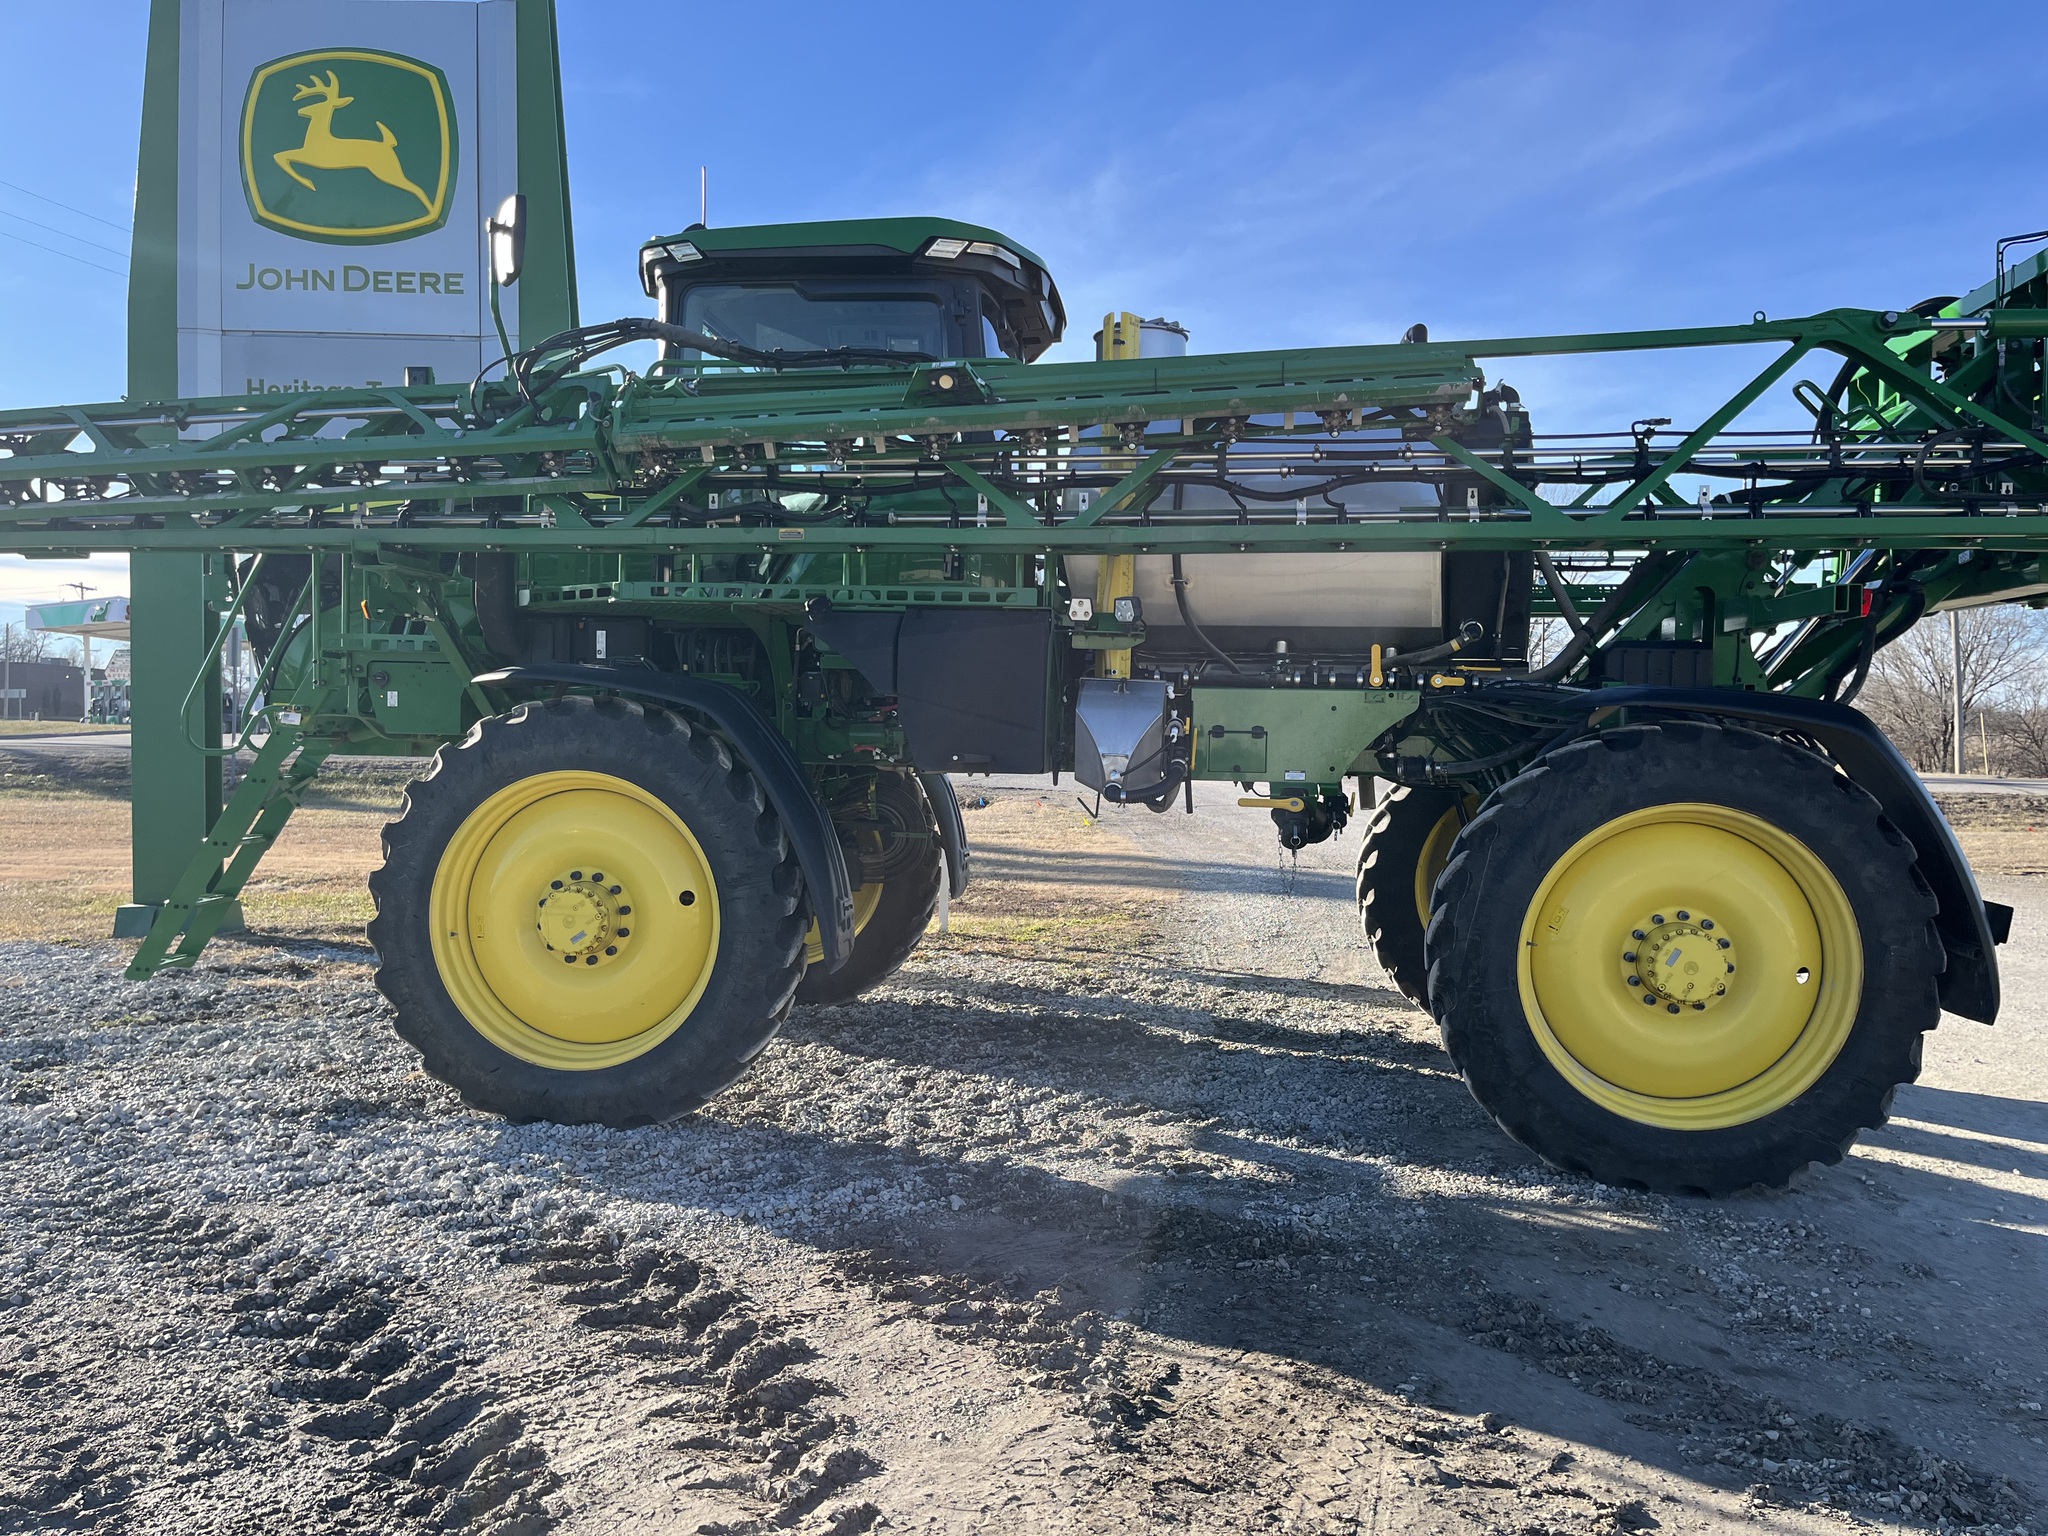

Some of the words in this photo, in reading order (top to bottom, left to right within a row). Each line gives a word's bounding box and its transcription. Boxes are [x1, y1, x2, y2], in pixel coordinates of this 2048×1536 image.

[236, 262, 335, 292] JOHN
[343, 264, 465, 295] DEERE
[246, 377, 354, 396] Herit
